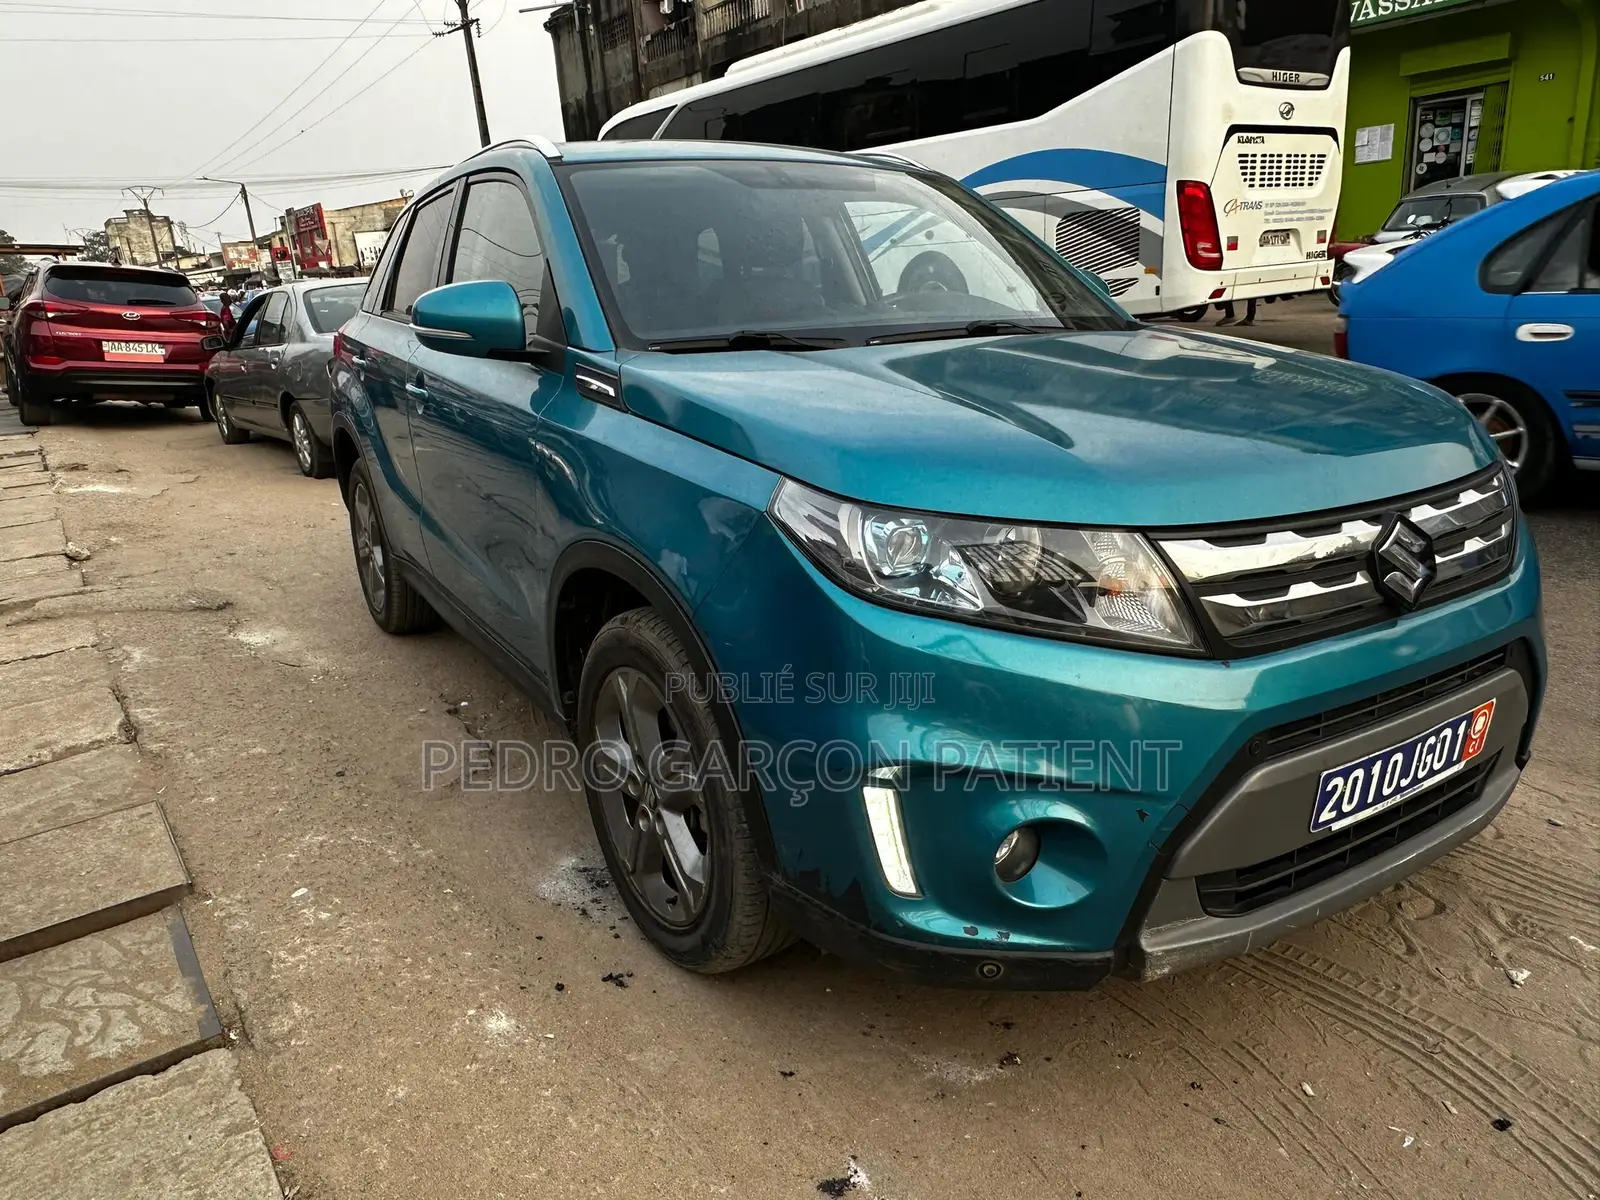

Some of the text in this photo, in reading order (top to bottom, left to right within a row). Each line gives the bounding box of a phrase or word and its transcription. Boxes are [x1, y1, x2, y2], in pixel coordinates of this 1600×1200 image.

[1272, 71, 1300, 83] HIGER
[1305, 250, 1327, 260] HIGER
[1318, 719, 1468, 823] 2010JG01
